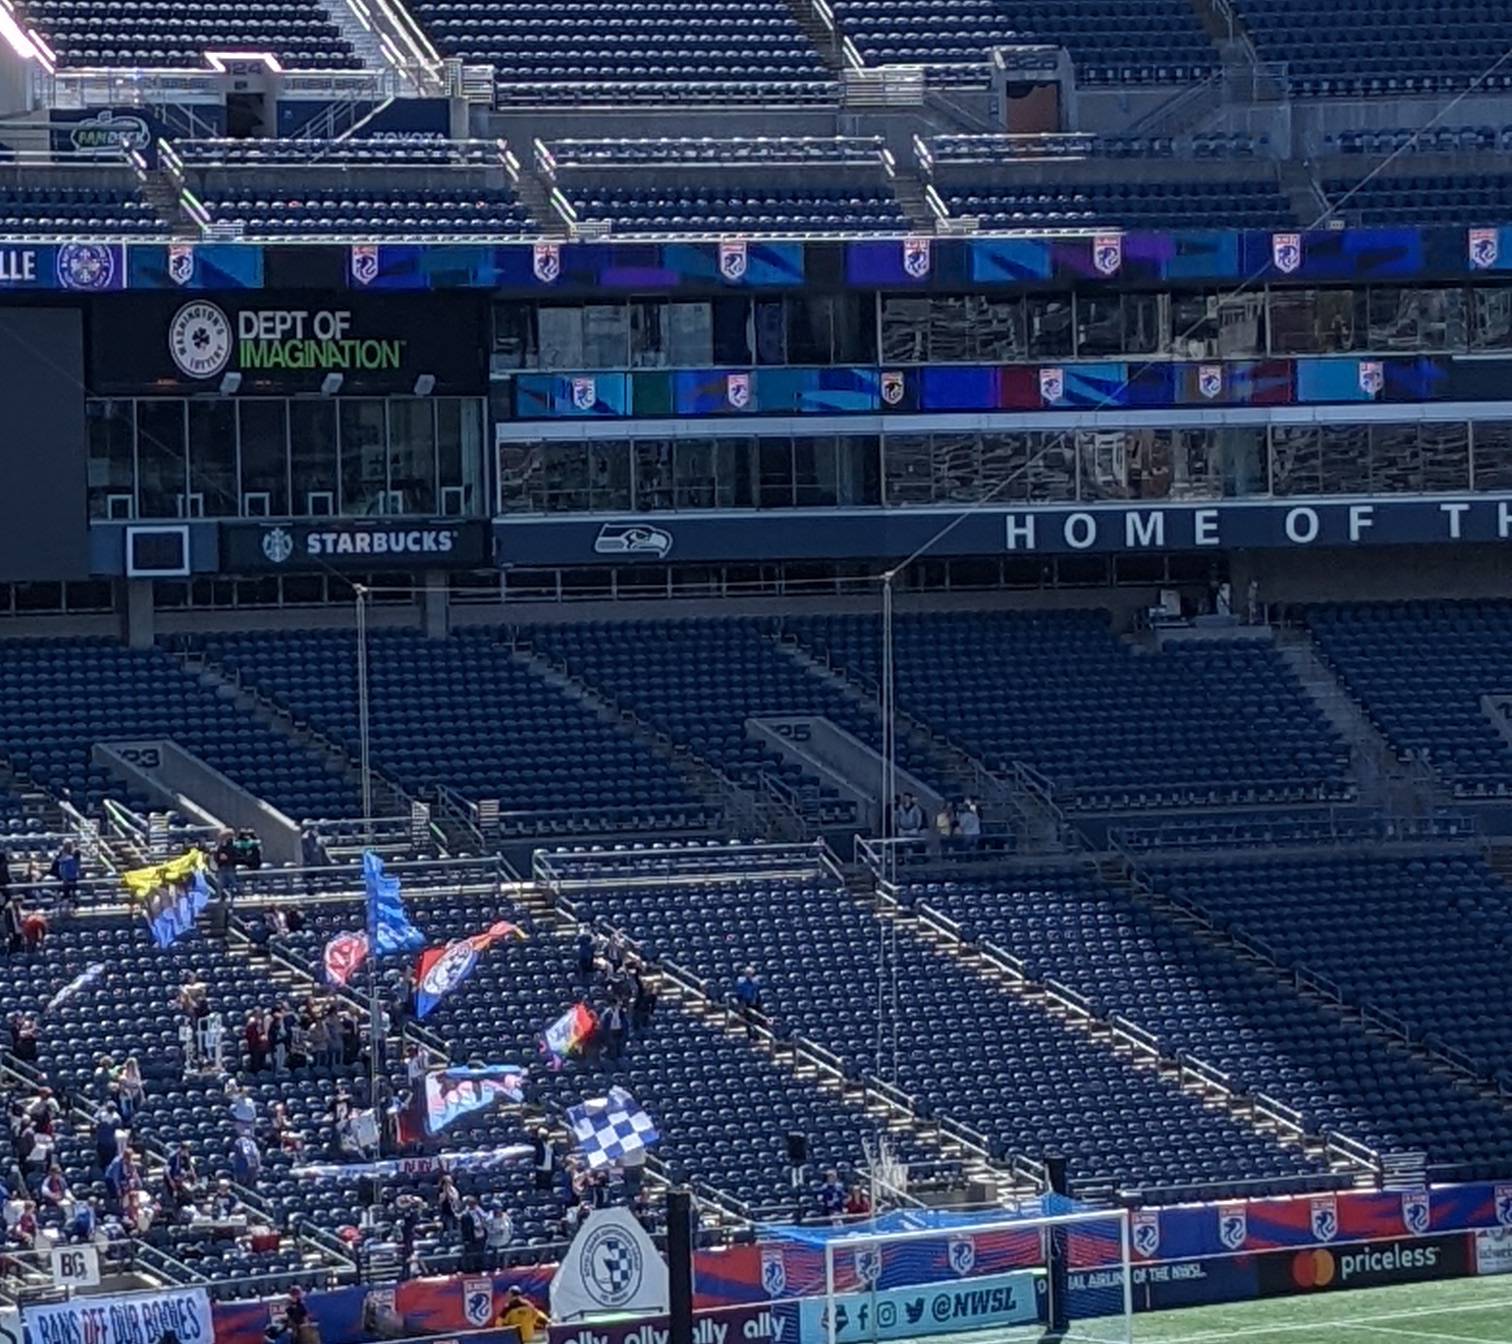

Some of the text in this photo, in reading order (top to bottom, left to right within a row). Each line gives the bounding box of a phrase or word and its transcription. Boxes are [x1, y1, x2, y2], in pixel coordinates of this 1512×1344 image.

[238, 310, 352, 340] DEPT OF
[239, 339, 401, 370] IMAGINATION
[306, 530, 454, 554] STARBUCKS
[1005, 509, 1221, 550] HOME
[1285, 505, 1374, 543] OF
[1150, 1265, 1170, 1282] THE
[1341, 1244, 1437, 1280] priceless
[931, 1286, 1017, 1322] @NWSL
[743, 1312, 786, 1342] ally
